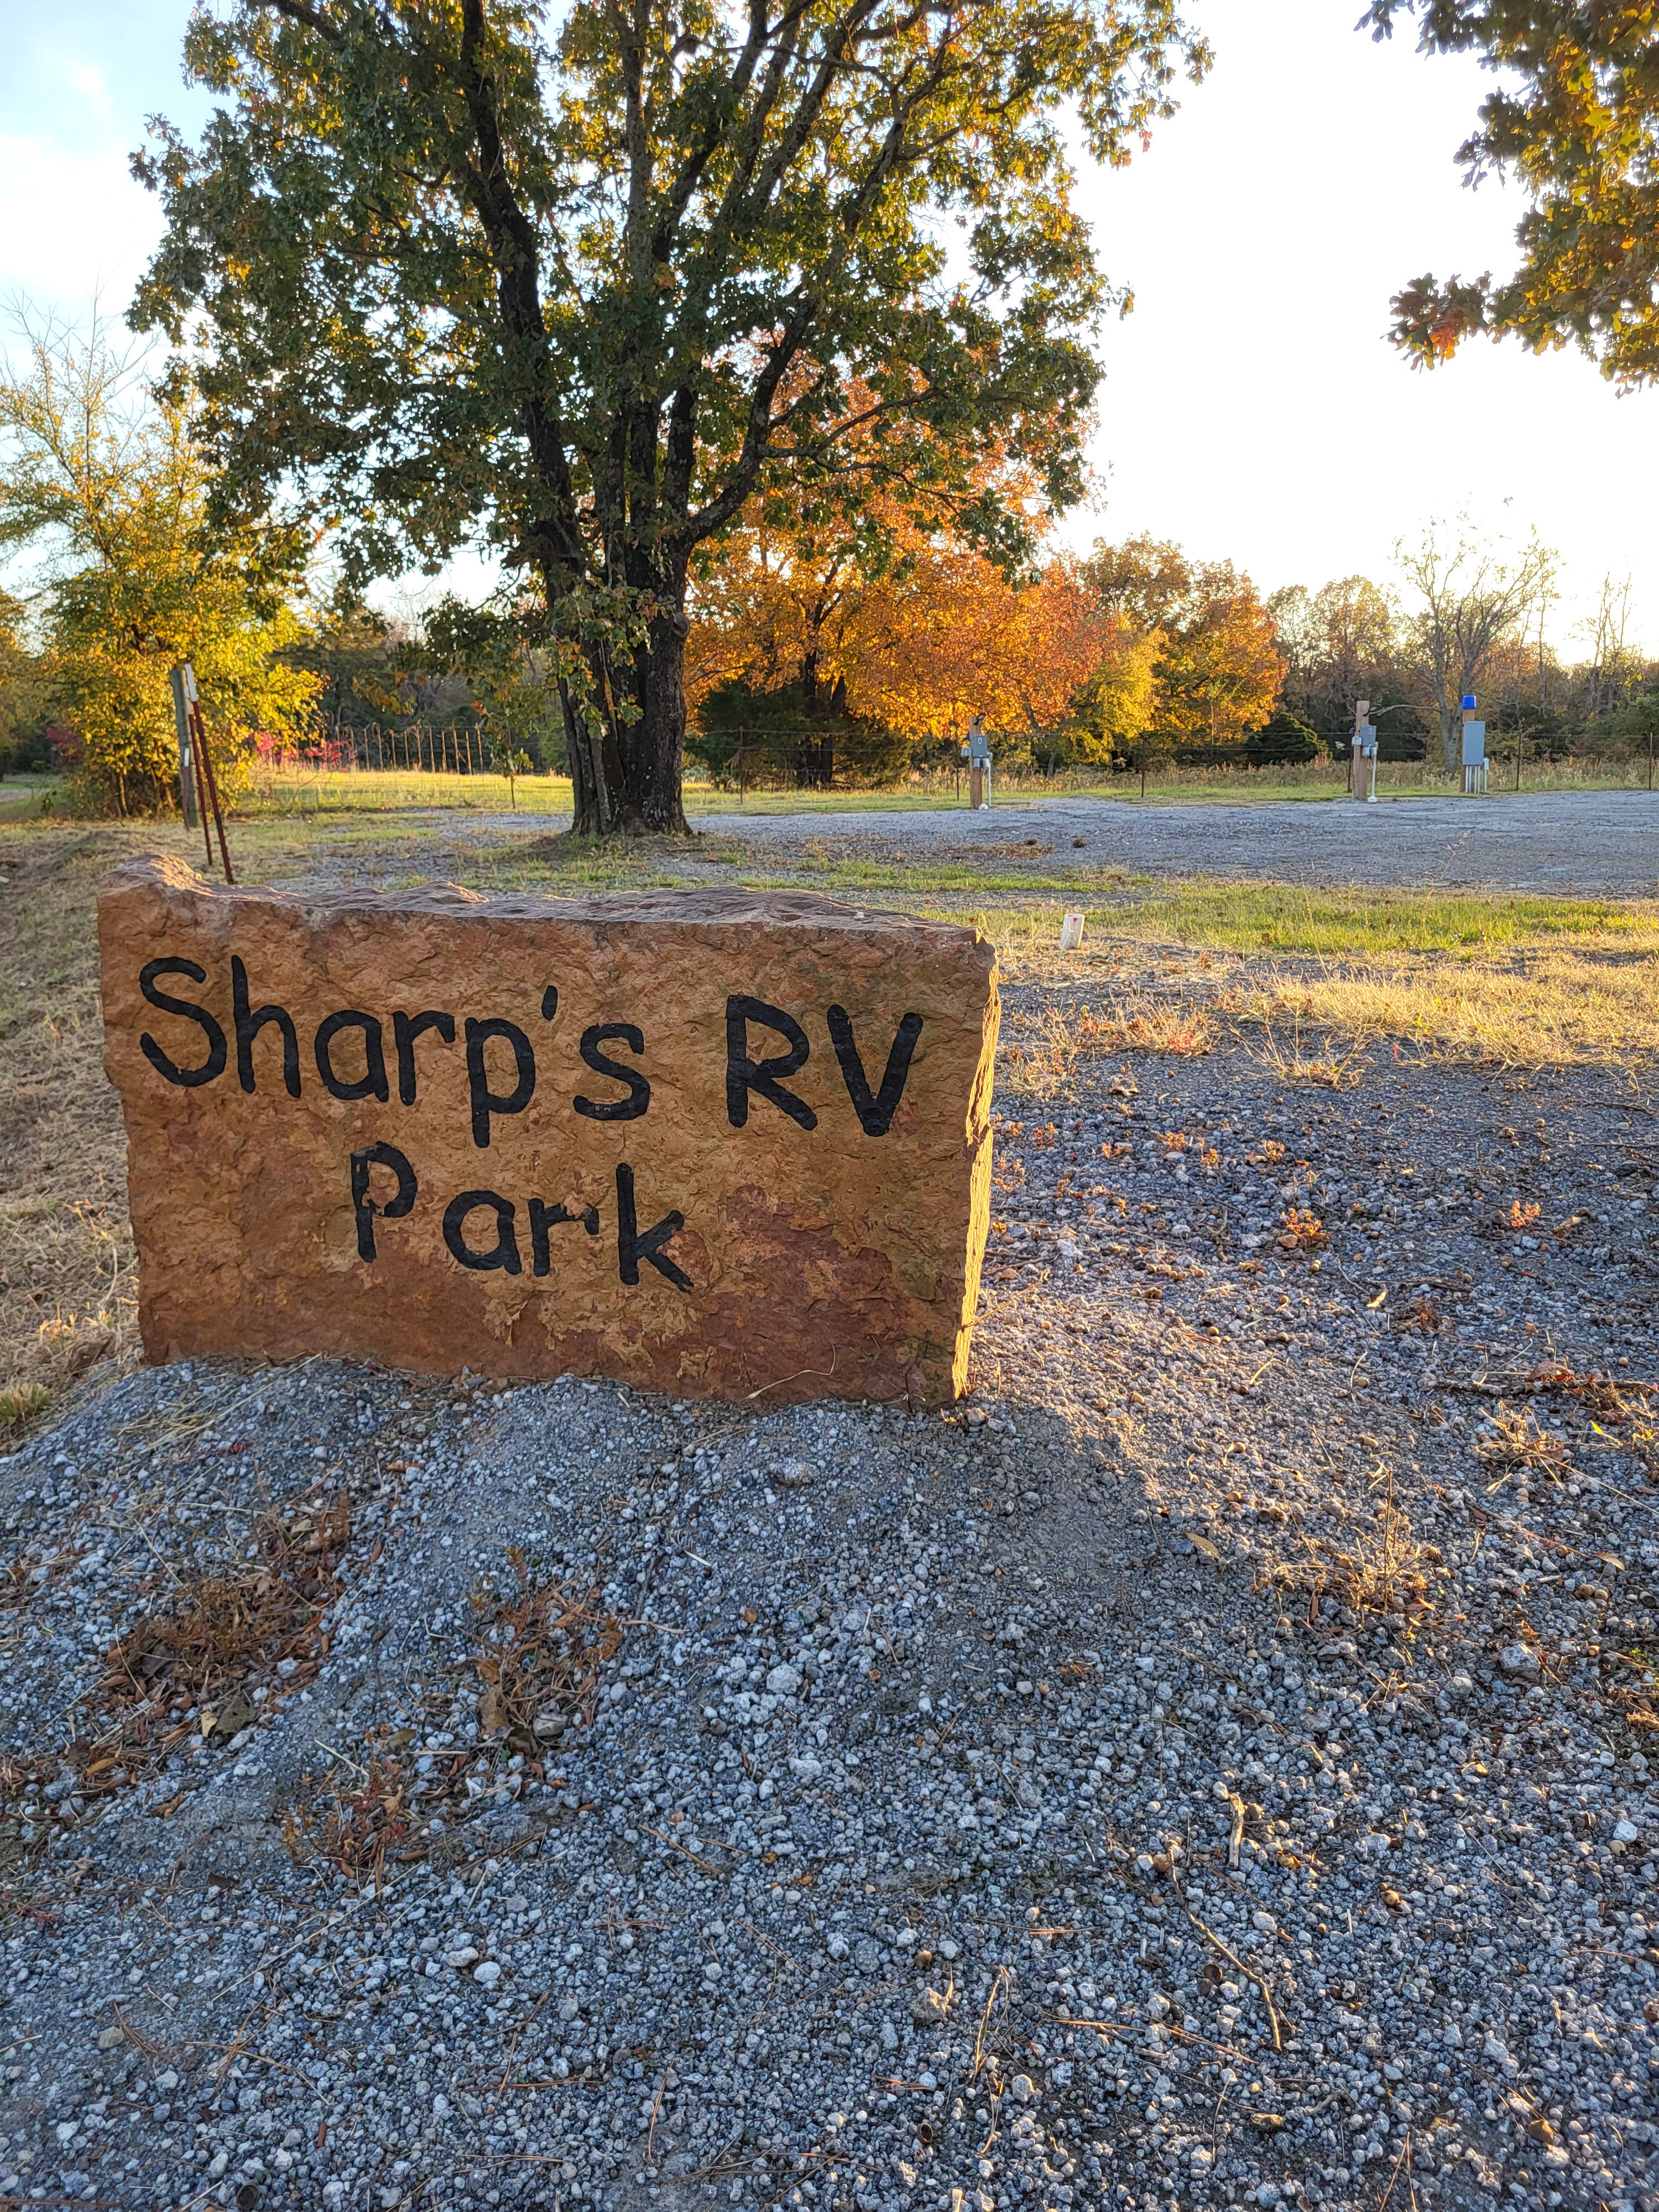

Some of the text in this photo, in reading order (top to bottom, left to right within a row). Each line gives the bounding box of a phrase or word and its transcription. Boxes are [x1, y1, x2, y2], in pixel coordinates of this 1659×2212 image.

[140, 955, 922, 1148] Sharp's RV
[351, 1141, 693, 1294] Park
